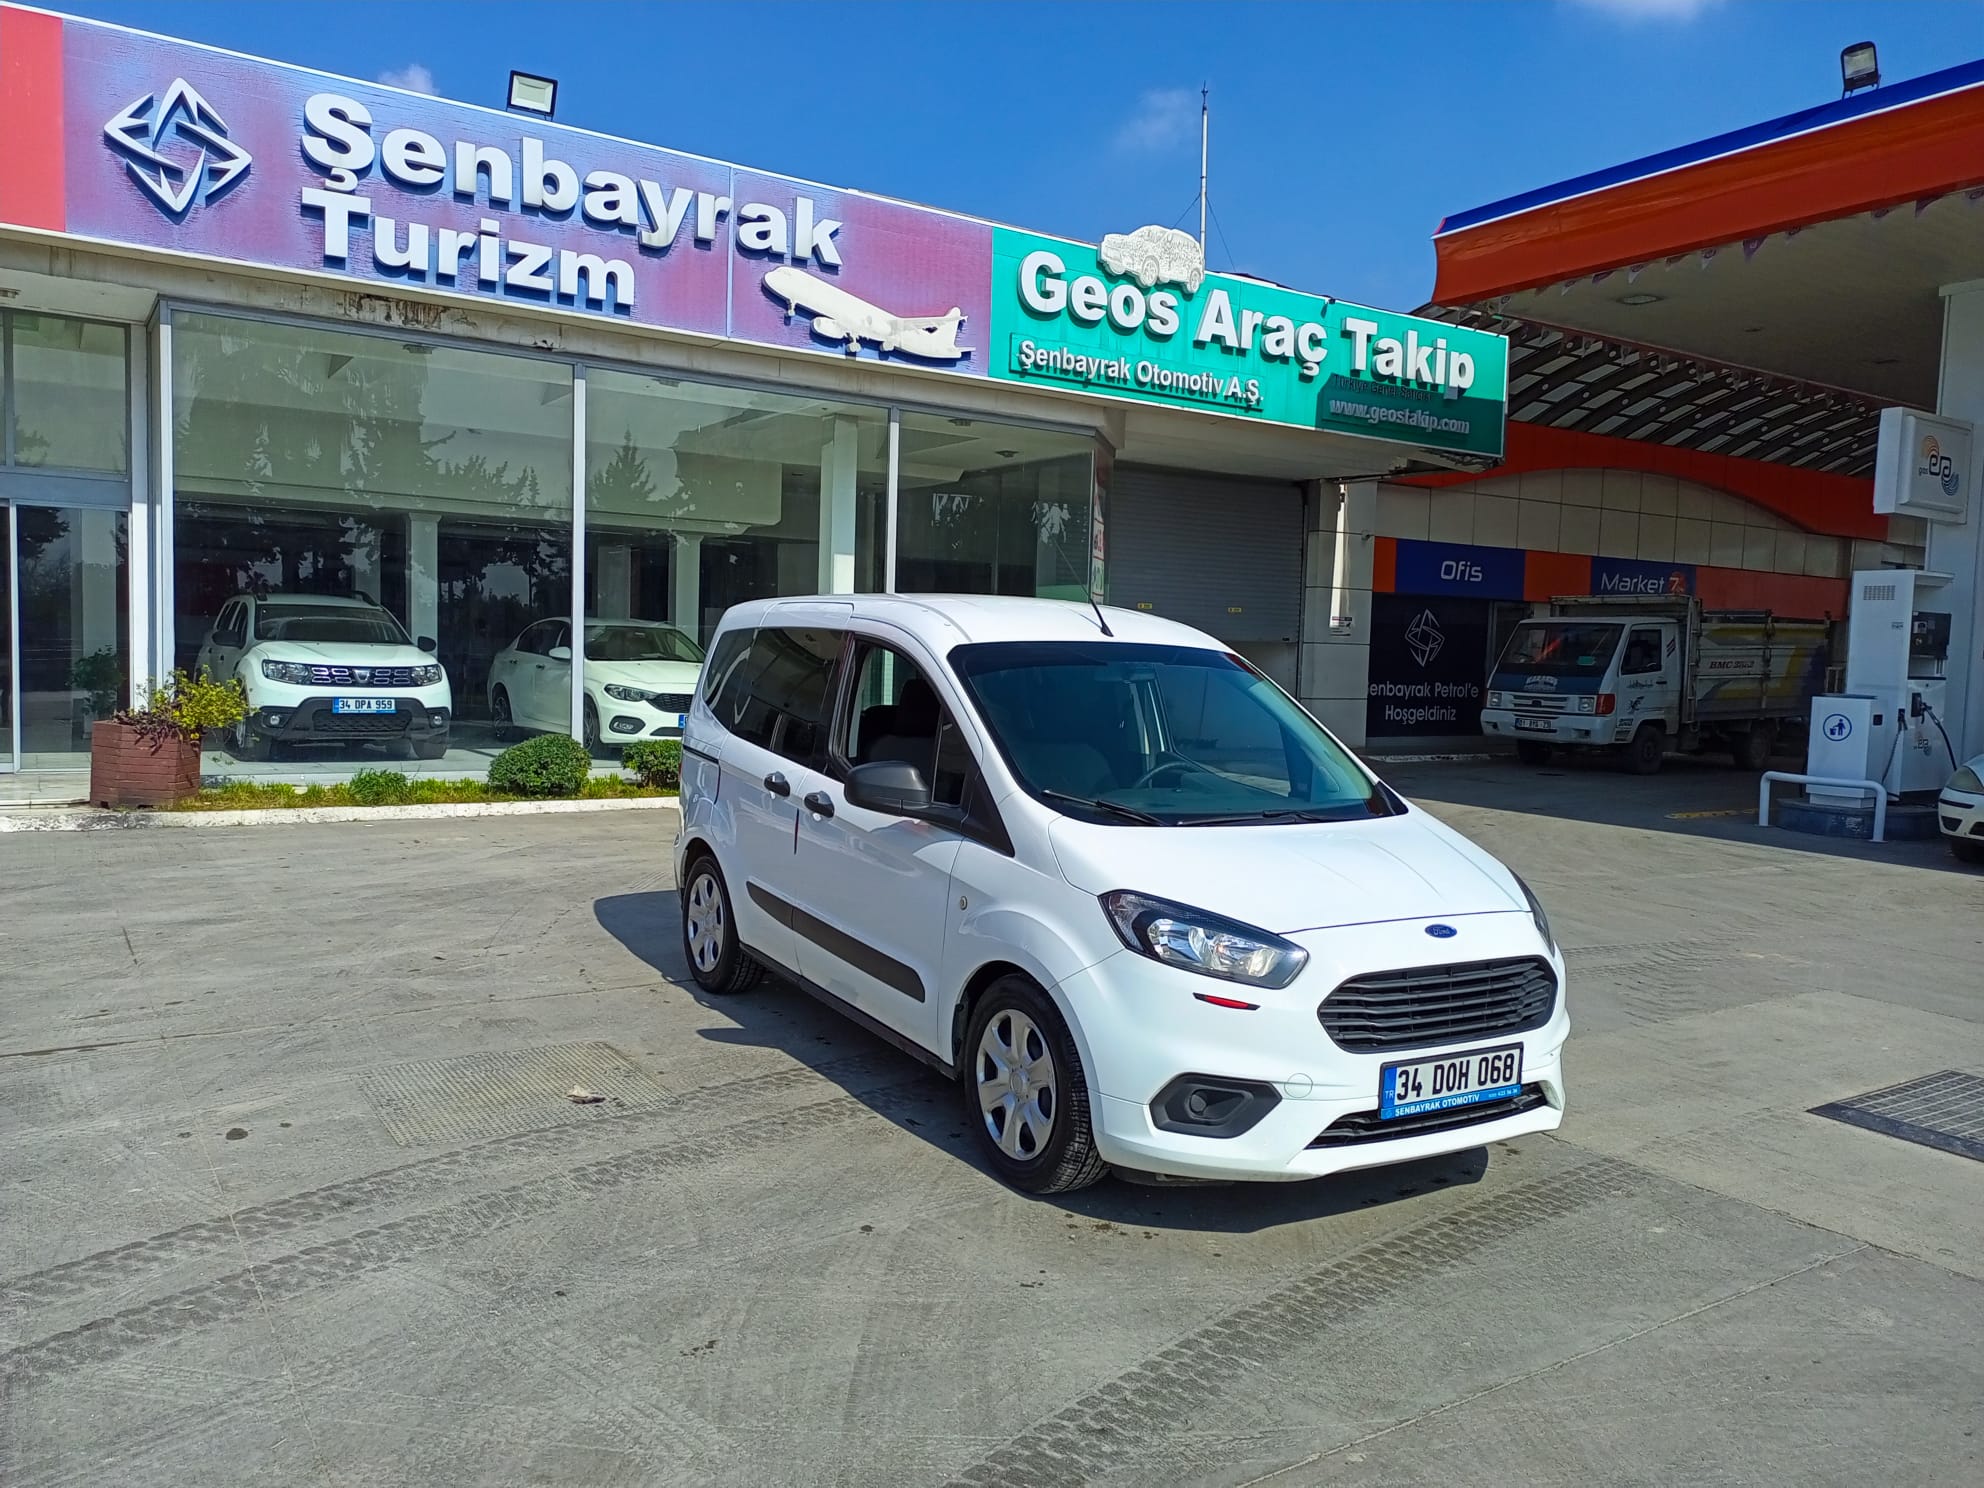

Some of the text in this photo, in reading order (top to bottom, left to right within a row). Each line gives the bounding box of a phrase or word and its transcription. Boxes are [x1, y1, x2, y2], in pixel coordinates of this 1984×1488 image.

[301, 92, 843, 266] Şenbayrak
[301, 186, 635, 307] Turizm
[1017, 250, 1476, 400] Geos Araç Takip
[1018, 339, 1131, 379] Şenbayrak
[1135, 359, 1224, 394] Otomotiv
[1329, 399, 1470, 435] www.geostakip.com
[1440, 560, 1483, 582] Ofis
[1600, 572, 1665, 593] Market
[340, 699, 351, 709] 34
[375, 699, 393, 709] 959
[1369, 681, 1479, 700] enbayrak Petrol'e
[1385, 704, 1457, 725] Hoşgeldiniz
[1396, 1053, 1515, 1100] 34 DOH 068
